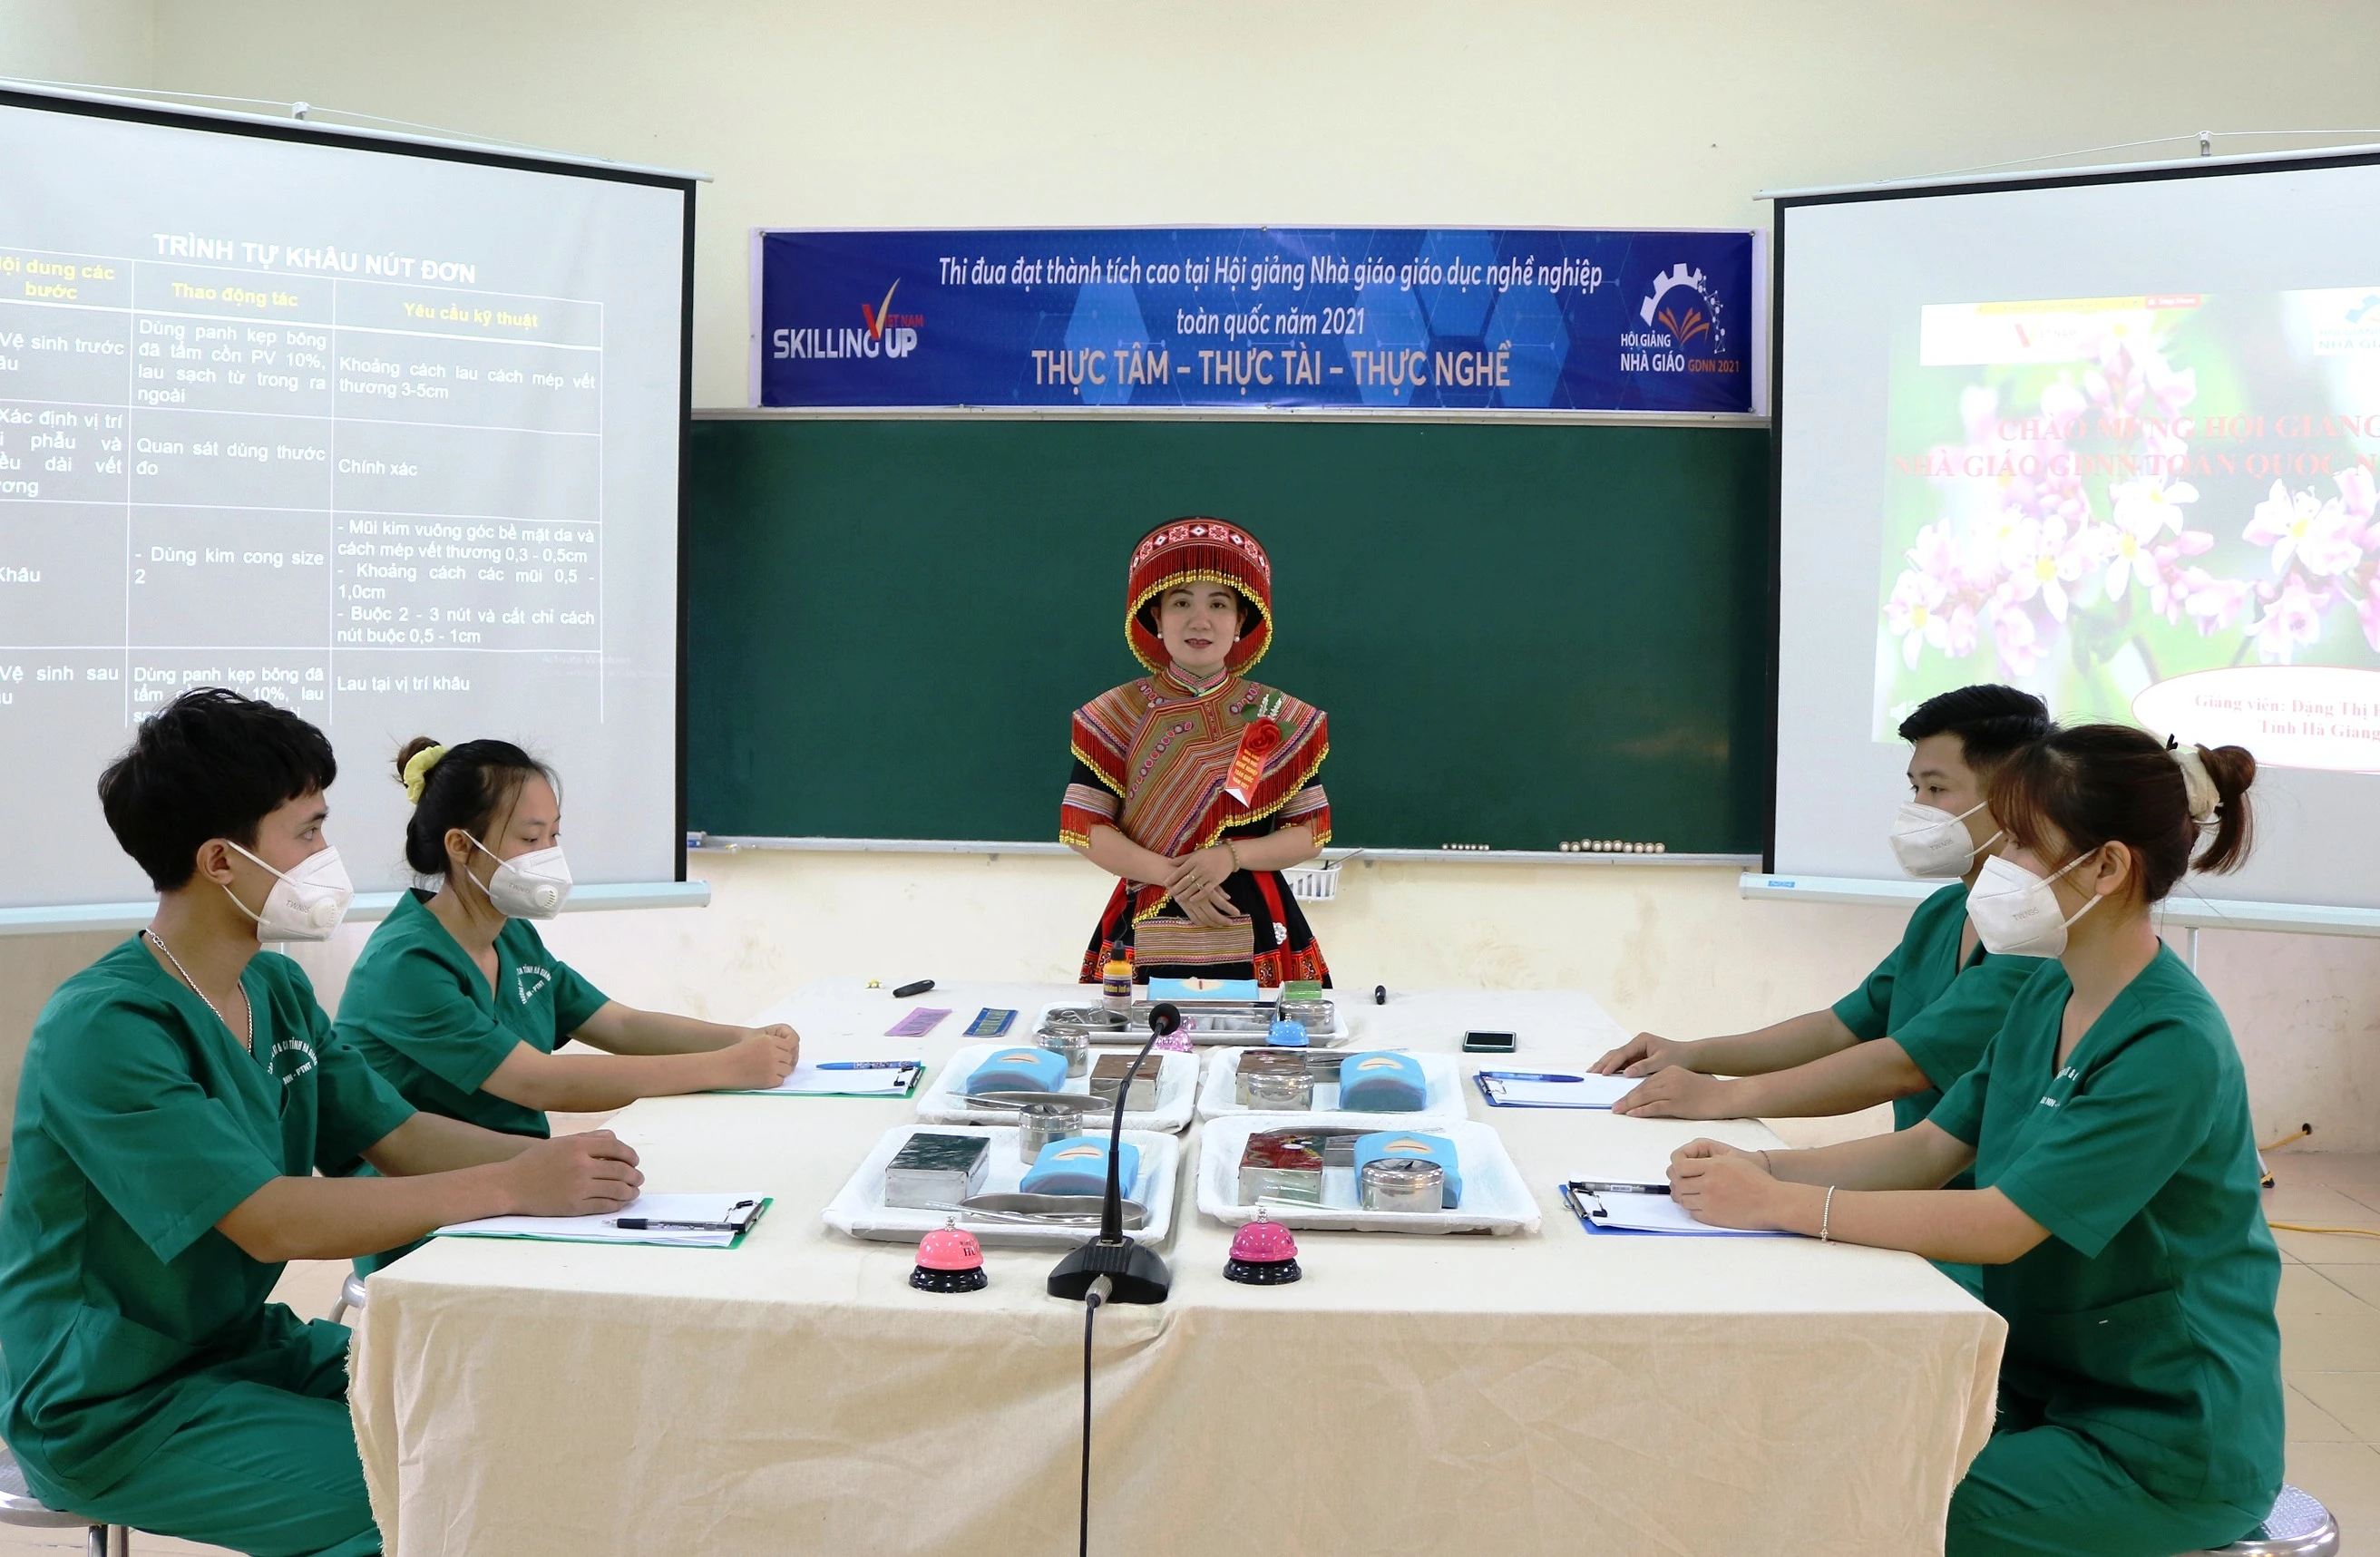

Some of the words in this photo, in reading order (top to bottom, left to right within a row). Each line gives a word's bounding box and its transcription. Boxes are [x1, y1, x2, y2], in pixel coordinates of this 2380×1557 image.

[153, 232, 233, 260] TRÌNH
[241, 241, 278, 270] TỰ
[286, 246, 356, 273] KHÂU
[365, 251, 415, 277] NÚT
[421, 259, 475, 284] ĐƠN
[26, 259, 75, 281] dung
[81, 264, 115, 281] các
[940, 257, 966, 286] Thi
[971, 257, 1006, 286] đua
[1010, 258, 1043, 293] đạt
[1047, 257, 1101, 285] thành
[1106, 257, 1141, 285] tích
[1146, 263, 1180, 285] cao
[1184, 257, 1211, 293] tại
[1214, 255, 1246, 293] Hội
[1251, 255, 1304, 291] giảng
[1311, 257, 1350, 285] Nhà
[1353, 257, 1396, 292] giáo
[1400, 257, 1443, 292] giáo
[1447, 257, 1481, 294] dục
[1487, 254, 1536, 293] nghề
[1538, 257, 1603, 295] nghiệp
[25, 281, 77, 300] bước
[171, 282, 217, 301] Thao
[222, 287, 267, 308] động
[272, 290, 298, 307] tác
[405, 302, 435, 319] Yêu
[440, 304, 468, 322] cầu
[473, 308, 492, 327] kỹ
[497, 311, 539, 331] thuật
[901, 314, 923, 327] NAM
[1177, 308, 1219, 336] toàn
[1223, 306, 1271, 342] quốc
[1275, 308, 1318, 335] năm
[1322, 307, 1364, 335] 2021
[31, 335, 68, 352] sinh
[75, 336, 124, 355] trước
[139, 319, 185, 341] Dùng
[196, 325, 237, 344] panh
[247, 327, 277, 346] kẹp
[287, 331, 327, 351] bông
[773, 327, 880, 359] SKILLING
[884, 327, 918, 359] UP
[1621, 331, 1638, 350] HỘI
[1640, 330, 1671, 347] GIẢNG
[138, 341, 161, 357] đã
[171, 342, 201, 360] tẩm
[211, 344, 241, 363] cồn
[251, 347, 276, 364] PV
[287, 349, 327, 370] 10%,
[1620, 349, 1649, 372] NHÀ
[1652, 350, 1685, 372] GIÁO
[1688, 359, 1715, 373] GDNN
[1718, 360, 1740, 373] 2021
[138, 364, 164, 379] lau
[176, 366, 216, 384] sạch
[228, 369, 246, 384] từ
[257, 373, 298, 391] trong
[309, 377, 326, 390] ra
[339, 356, 400, 379] Khoảng
[409, 363, 446, 378] cách
[455, 365, 478, 381] lau
[487, 368, 523, 384] cách
[532, 373, 564, 390] mép
[572, 371, 595, 390] vết
[1032, 348, 1107, 395] THỰC
[1114, 342, 1168, 384] TÂM
[1198, 348, 1273, 395] THỰC
[1283, 348, 1321, 385] TÀI
[1351, 348, 1427, 396] THỰC
[1434, 339, 1511, 387] NGHỀ
[138, 387, 185, 404] ngoài
[339, 377, 396, 399] thương
[402, 382, 448, 399] 3-5cm
[0, 408, 33, 424] Xác
[39, 410, 77, 429] định
[83, 413, 98, 431] vị
[105, 414, 123, 429] trí
[1997, 413, 2087, 442] CHÀO
[2204, 413, 2264, 444] HỘI
[31, 430, 75, 452] phẫu
[102, 436, 122, 452] và
[137, 437, 183, 455] Quan
[192, 440, 219, 456] sát
[227, 443, 268, 462] dùng
[277, 444, 326, 462] thước
[45, 455, 72, 472] dài
[95, 456, 122, 474] vết
[136, 461, 158, 476] đo
[338, 459, 385, 475] Chính
[390, 462, 417, 477] xác
[1894, 448, 1955, 478] NHÀ
[1962, 448, 2043, 478] GIÁO
[2048, 453, 2141, 478] GDNN
[2246, 447, 2346, 480] QUỐC
[349, 519, 377, 535] Mũi
[383, 521, 410, 536] kim
[415, 523, 462, 540] vuông
[466, 525, 493, 541] góc
[499, 523, 517, 540] bề
[522, 526, 551, 544] mặt
[554, 528, 572, 542] da
[577, 530, 594, 543] và
[151, 546, 196, 567] Dùng
[206, 547, 234, 563] kim
[243, 551, 283, 568] cong
[292, 550, 324, 565] size
[135, 569, 145, 585] 2
[356, 562, 416, 580] Khoảng
[515, 568, 542, 582] mũi
[554, 568, 578, 584] 0,5
[338, 583, 385, 600] 1,0cm
[351, 606, 391, 623] Buộc
[398, 608, 408, 621] 2
[429, 608, 439, 621] 3
[502, 607, 524, 625] cắt
[532, 608, 553, 624] chỉ
[337, 676, 366, 691] Lau
[372, 676, 390, 693] tại
[395, 676, 407, 694] vị
[413, 676, 428, 691] trí
[433, 676, 470, 691] khâu
